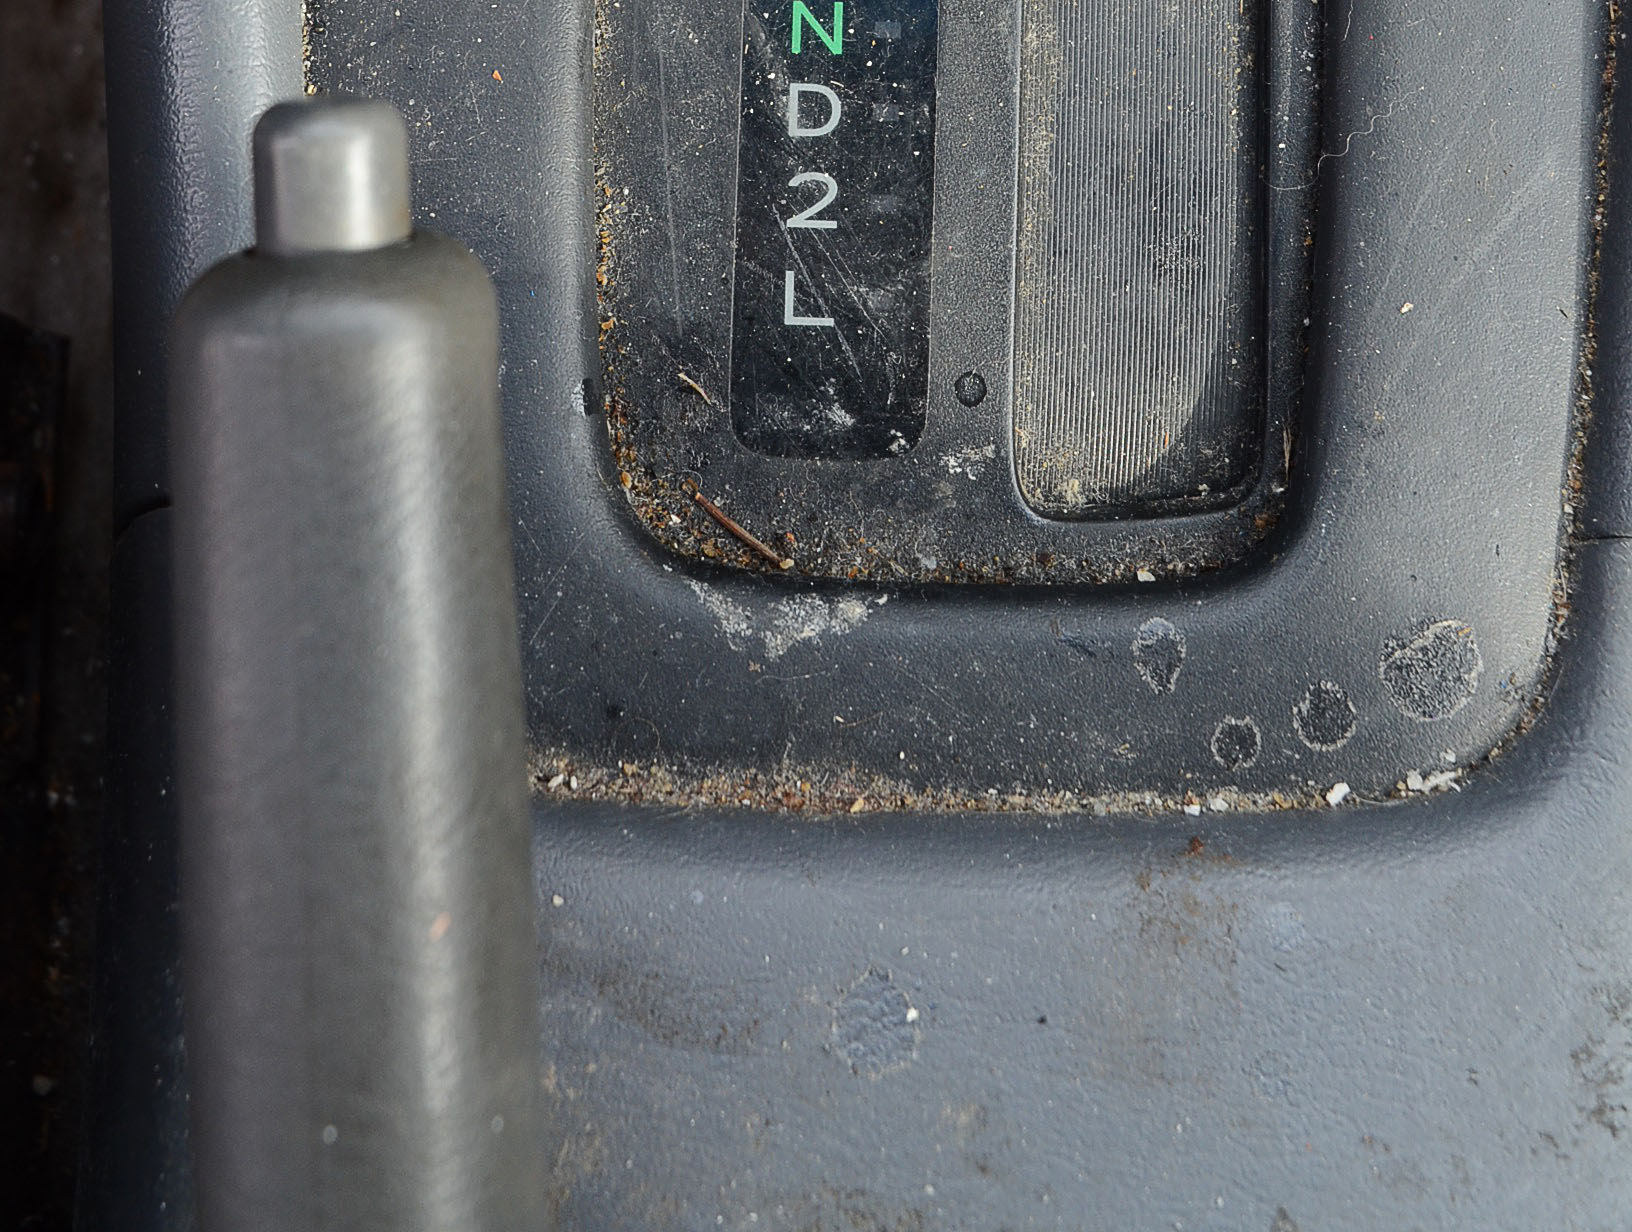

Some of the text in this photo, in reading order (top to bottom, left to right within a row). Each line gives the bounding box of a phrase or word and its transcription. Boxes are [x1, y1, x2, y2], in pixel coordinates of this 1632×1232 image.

[791, 0, 843, 55] N
[788, 83, 842, 137] D
[786, 172, 838, 228] 2
[784, 270, 835, 325] L
